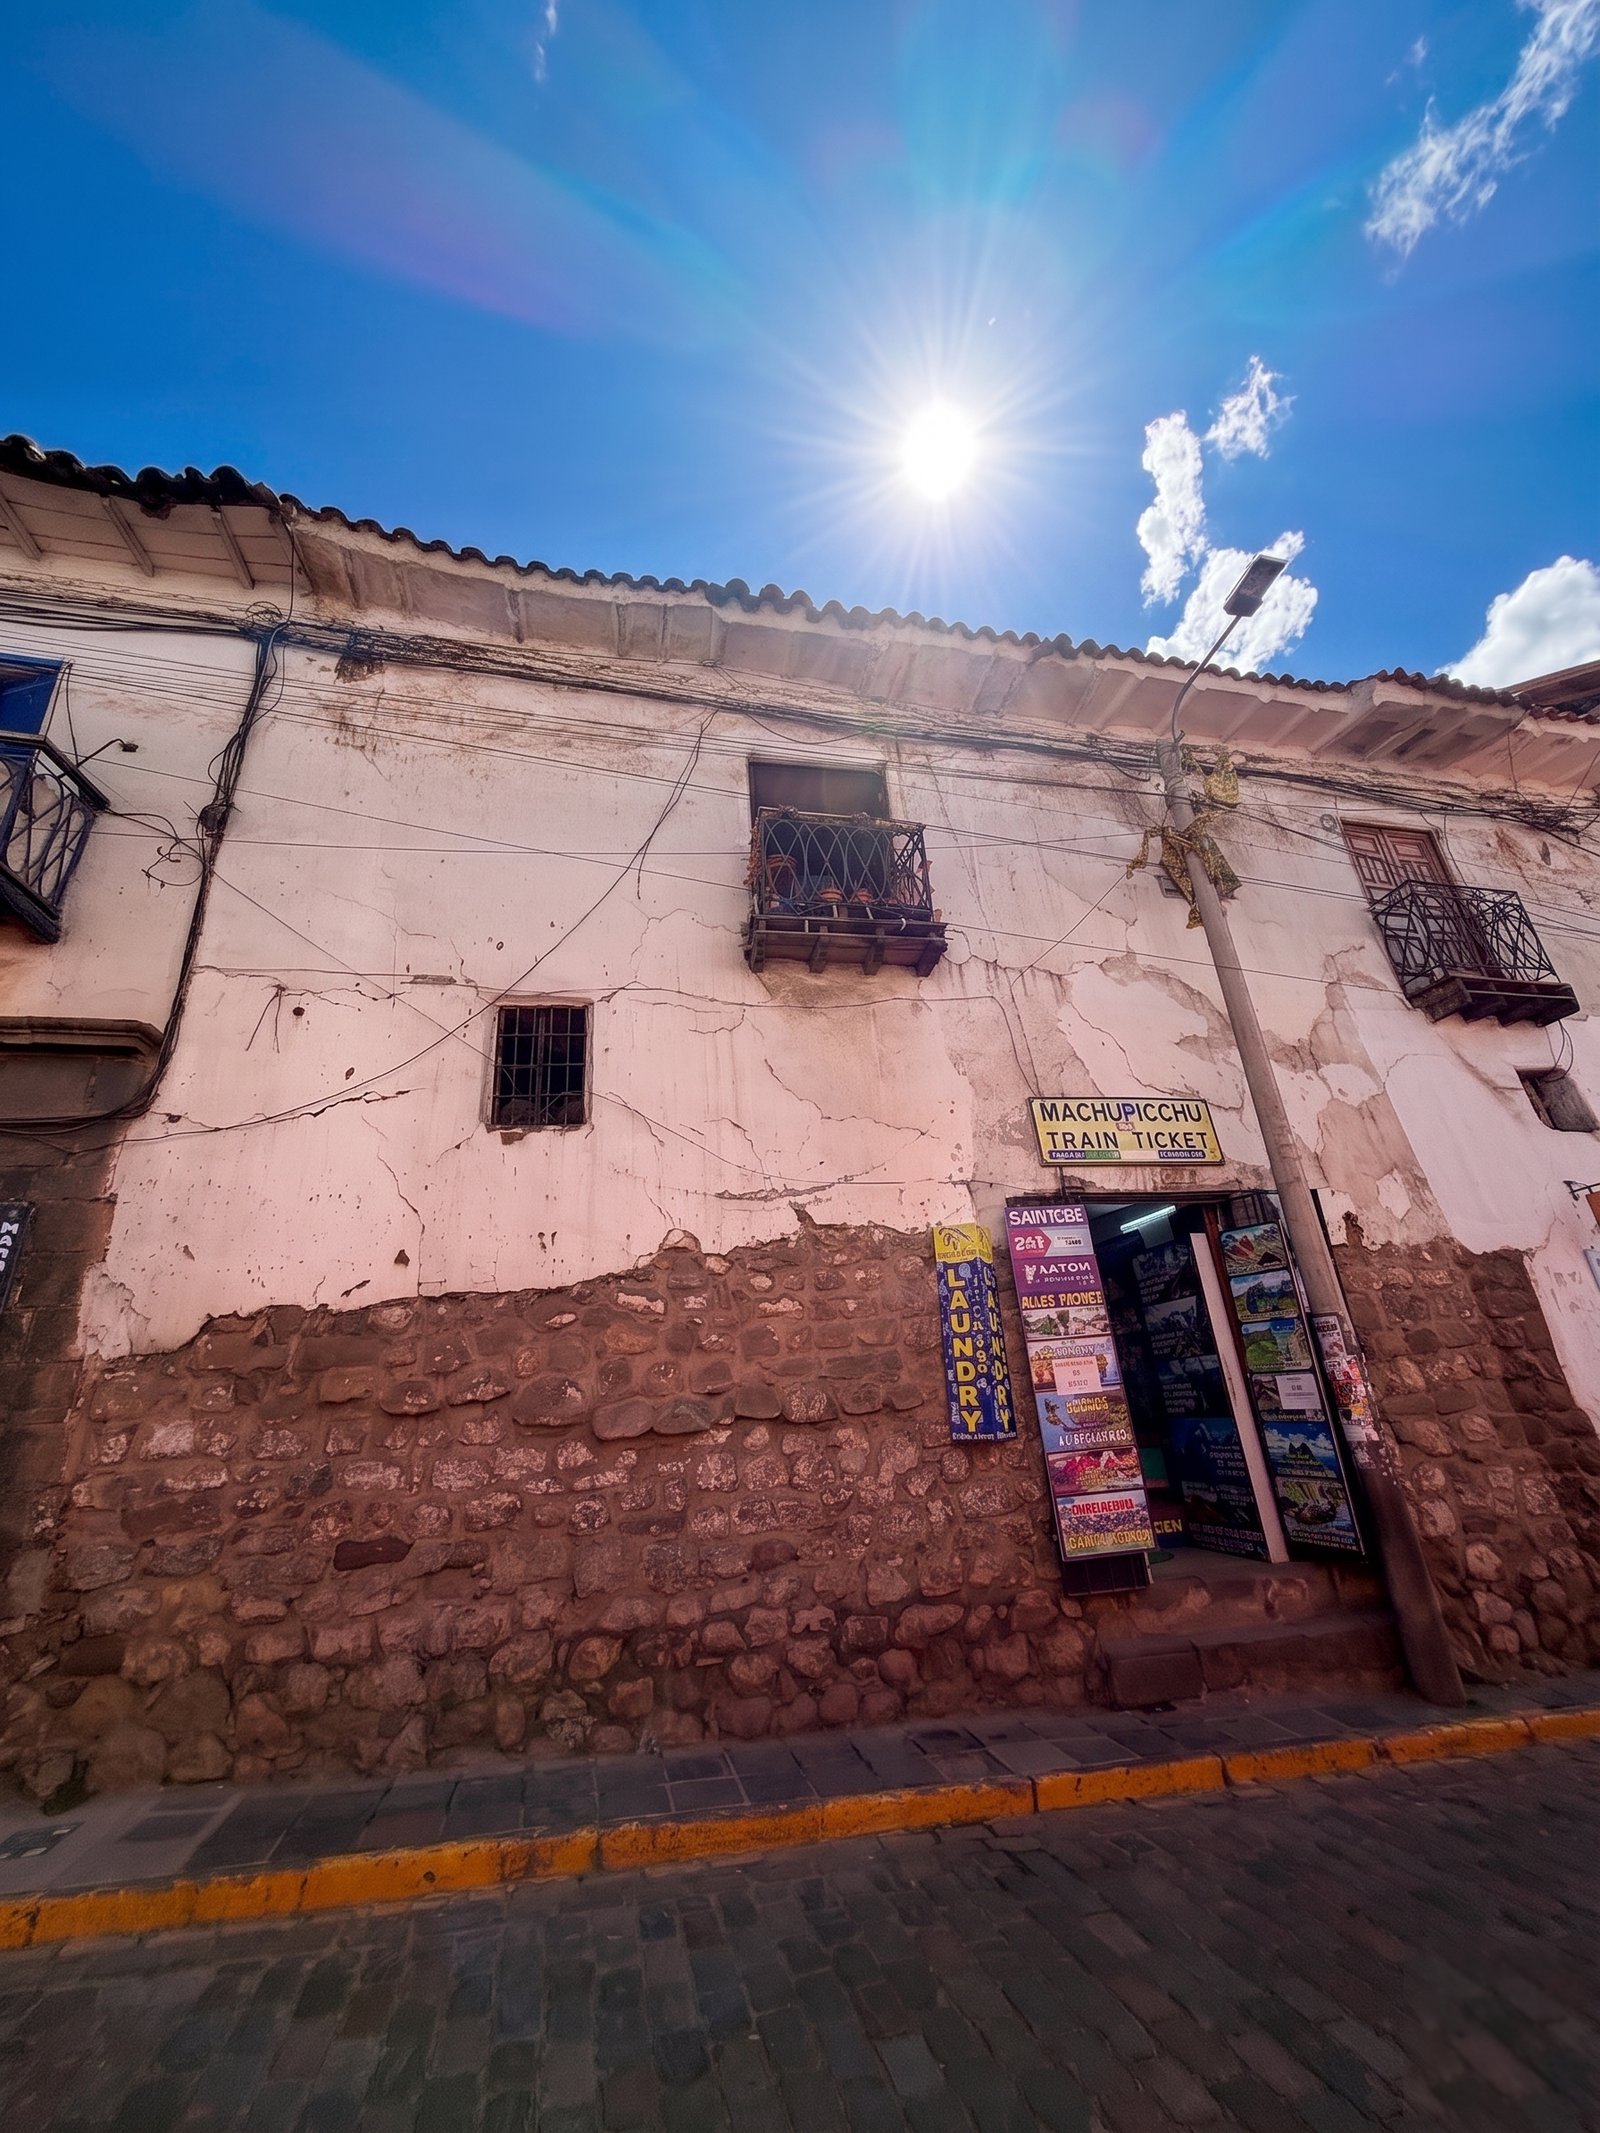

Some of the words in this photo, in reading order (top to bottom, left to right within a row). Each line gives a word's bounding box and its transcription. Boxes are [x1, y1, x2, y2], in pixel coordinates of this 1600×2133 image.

[1039, 1102, 1203, 1123] MACHUPICCHU
[1046, 1131, 1120, 1150] TRAIN
[1131, 1131, 1209, 1150] TICKET
[947, 1268, 982, 1433] LAUNDRY
[983, 1266, 1009, 1433] LAUNDRY
